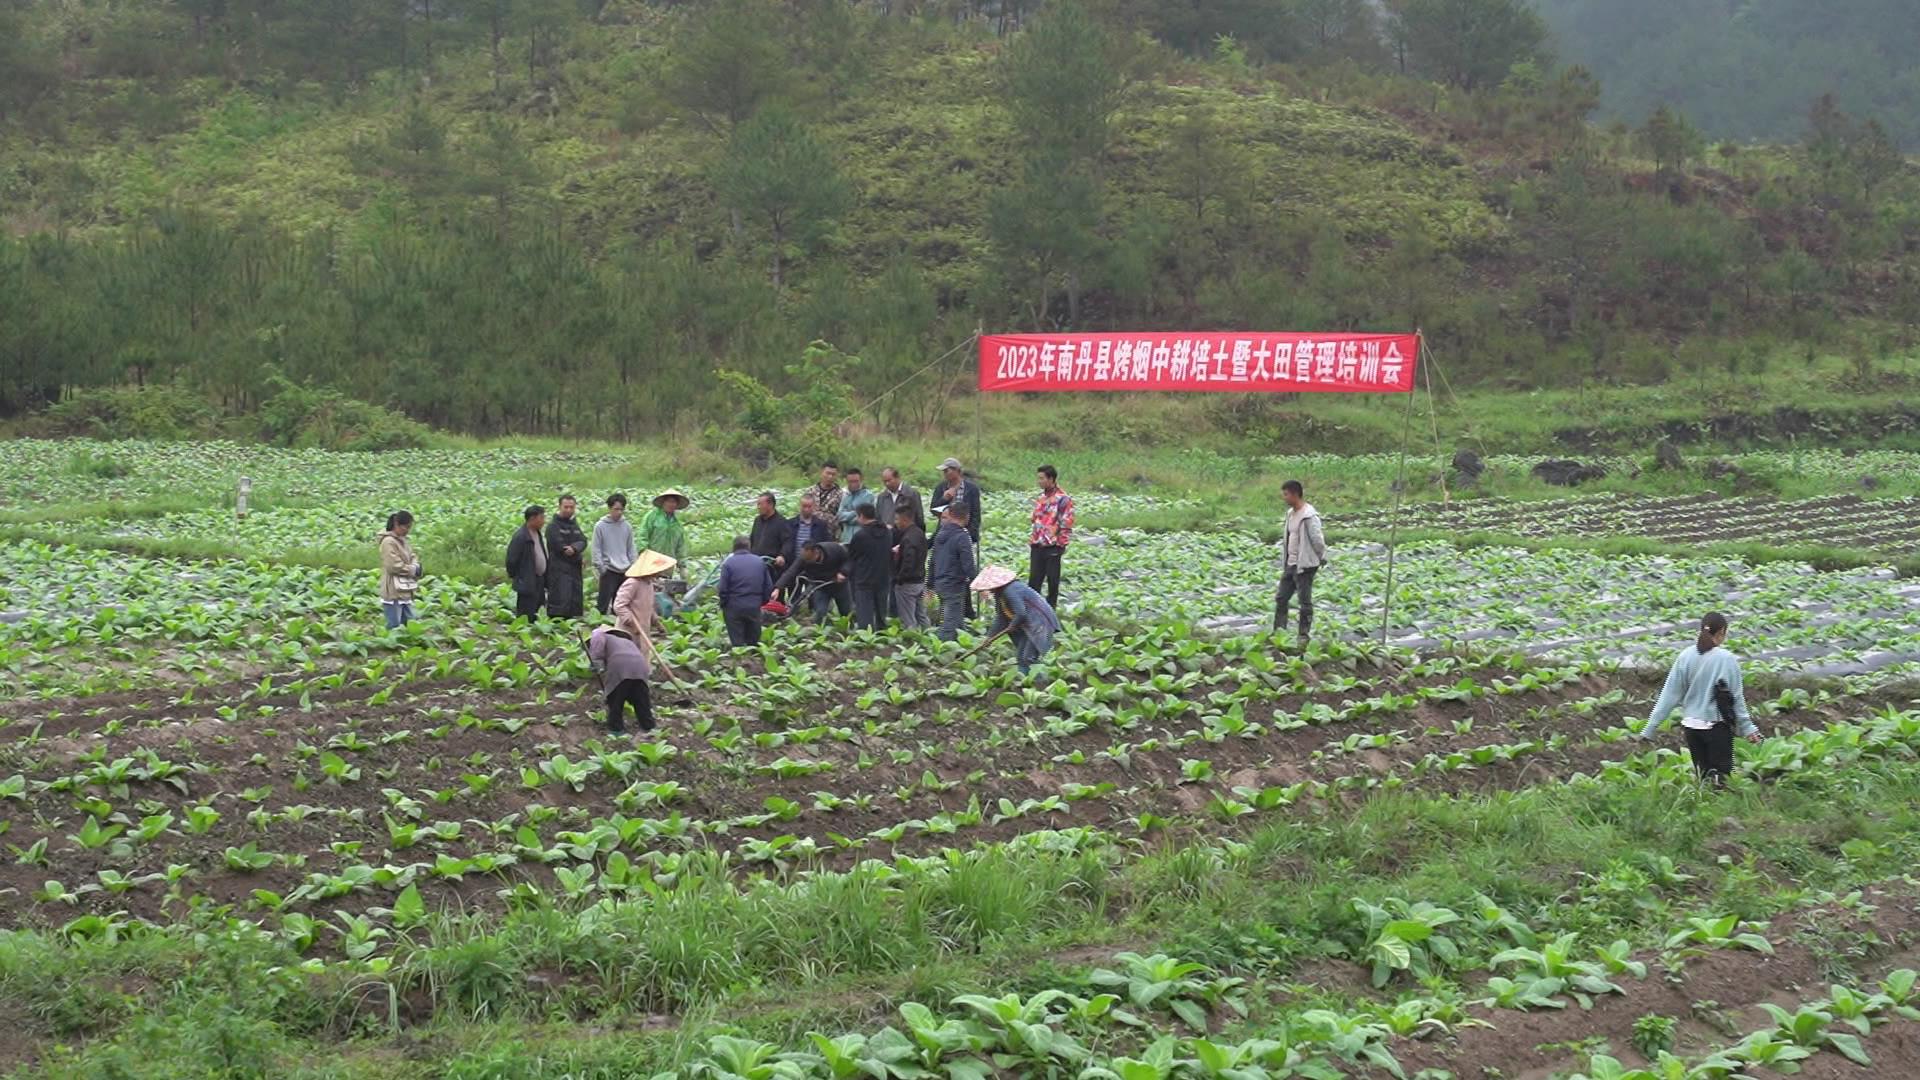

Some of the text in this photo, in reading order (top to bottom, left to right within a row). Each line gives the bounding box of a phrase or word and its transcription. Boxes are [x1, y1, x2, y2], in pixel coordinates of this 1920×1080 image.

[997, 340, 1403, 384] 2023年南丹县烤烟中耕培土暨大田管理培训会
